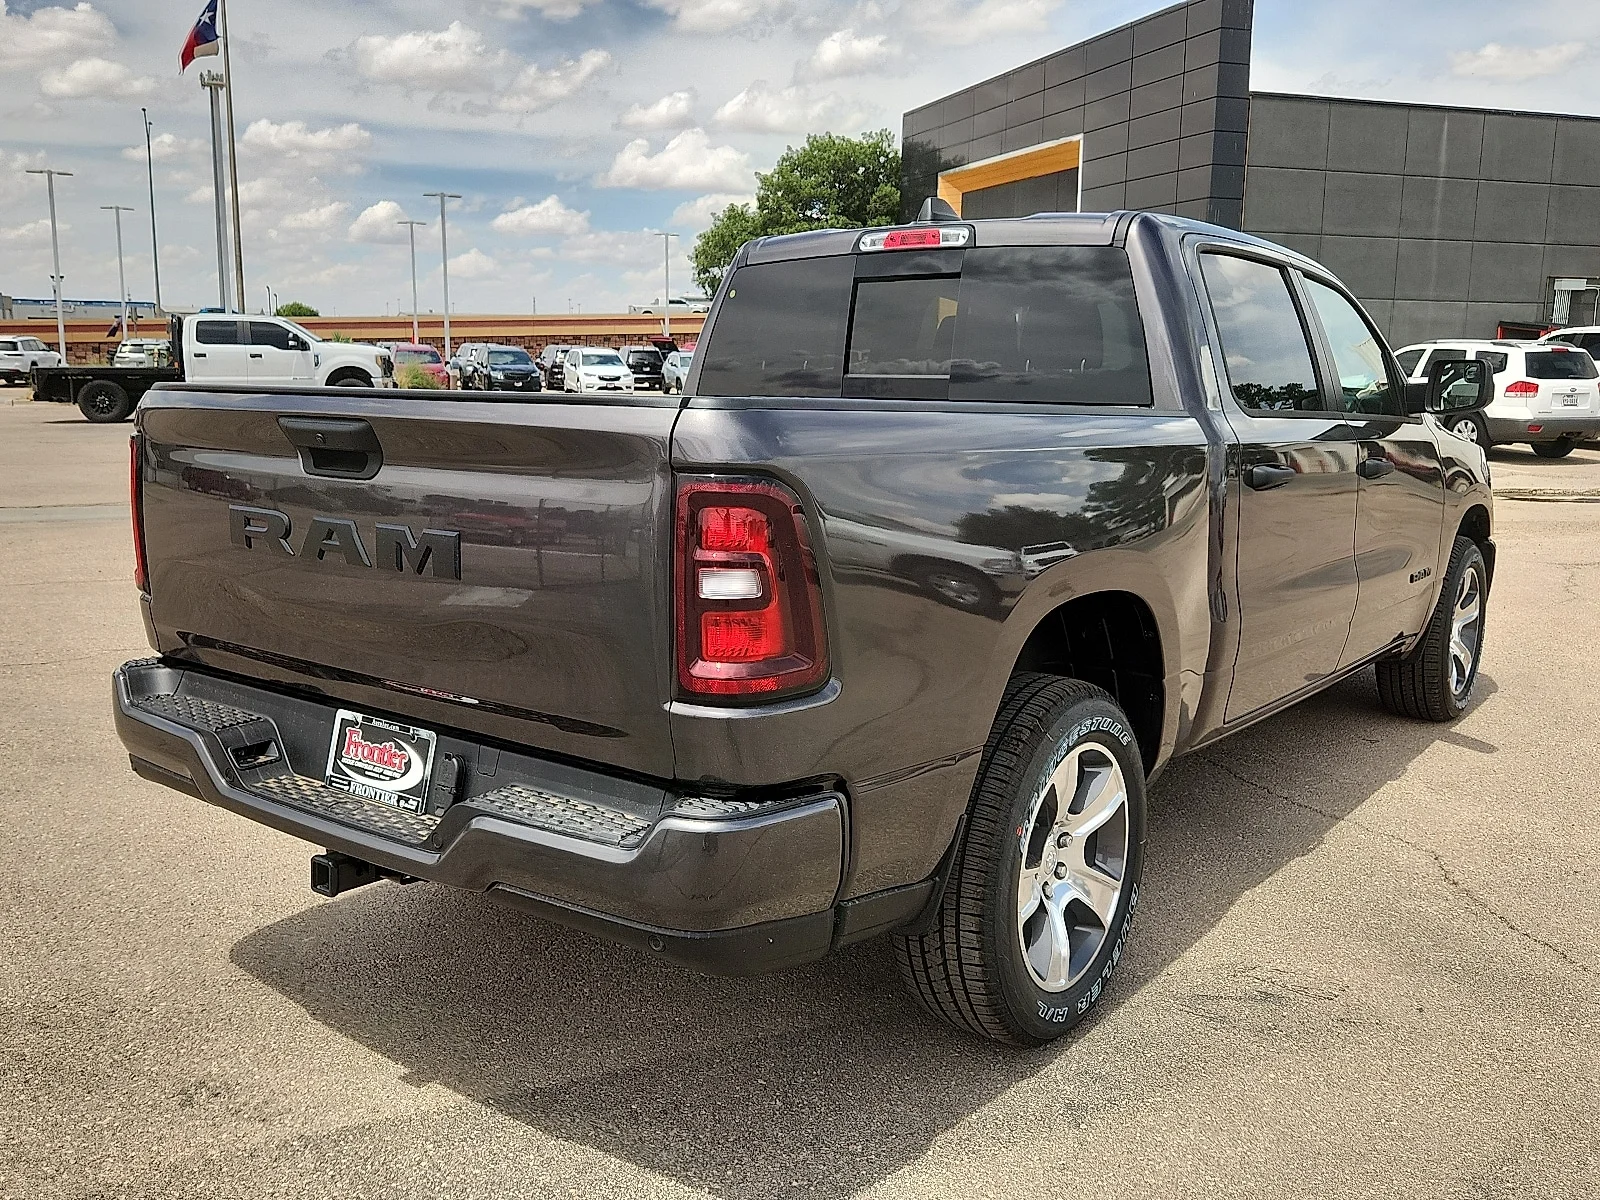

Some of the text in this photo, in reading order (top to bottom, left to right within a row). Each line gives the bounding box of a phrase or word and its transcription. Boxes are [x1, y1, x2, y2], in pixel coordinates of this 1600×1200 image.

[228, 503, 462, 581] RAM
[343, 728, 408, 772] Frontier
[349, 779, 399, 808] FRONTIER
[1076, 882, 1139, 1014] DUELER
